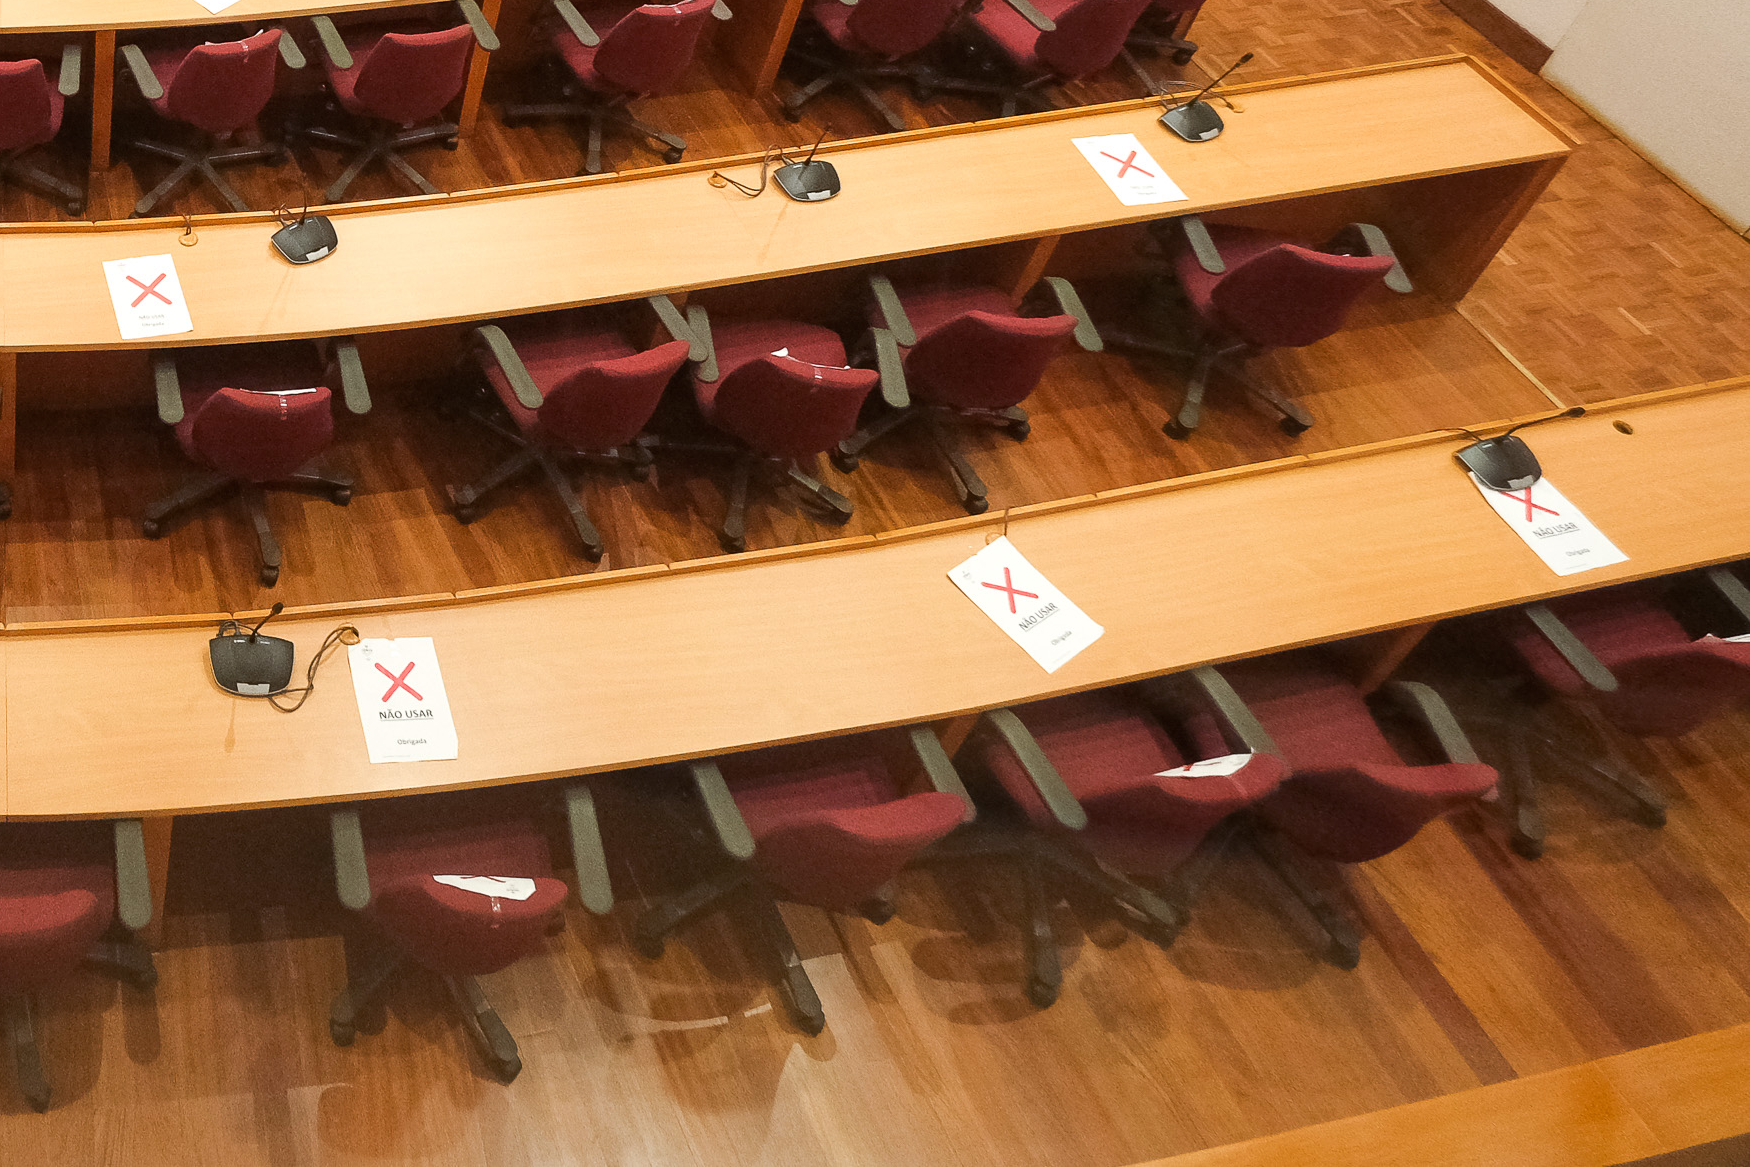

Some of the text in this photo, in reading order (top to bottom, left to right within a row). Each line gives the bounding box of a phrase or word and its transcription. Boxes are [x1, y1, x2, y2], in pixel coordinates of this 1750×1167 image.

[1532, 522, 1578, 538] NÃO USAR
[1018, 602, 1058, 630] NÃO USAR
[379, 709, 434, 720] NÃO USAR
[397, 738, 427, 746] Obrigada
